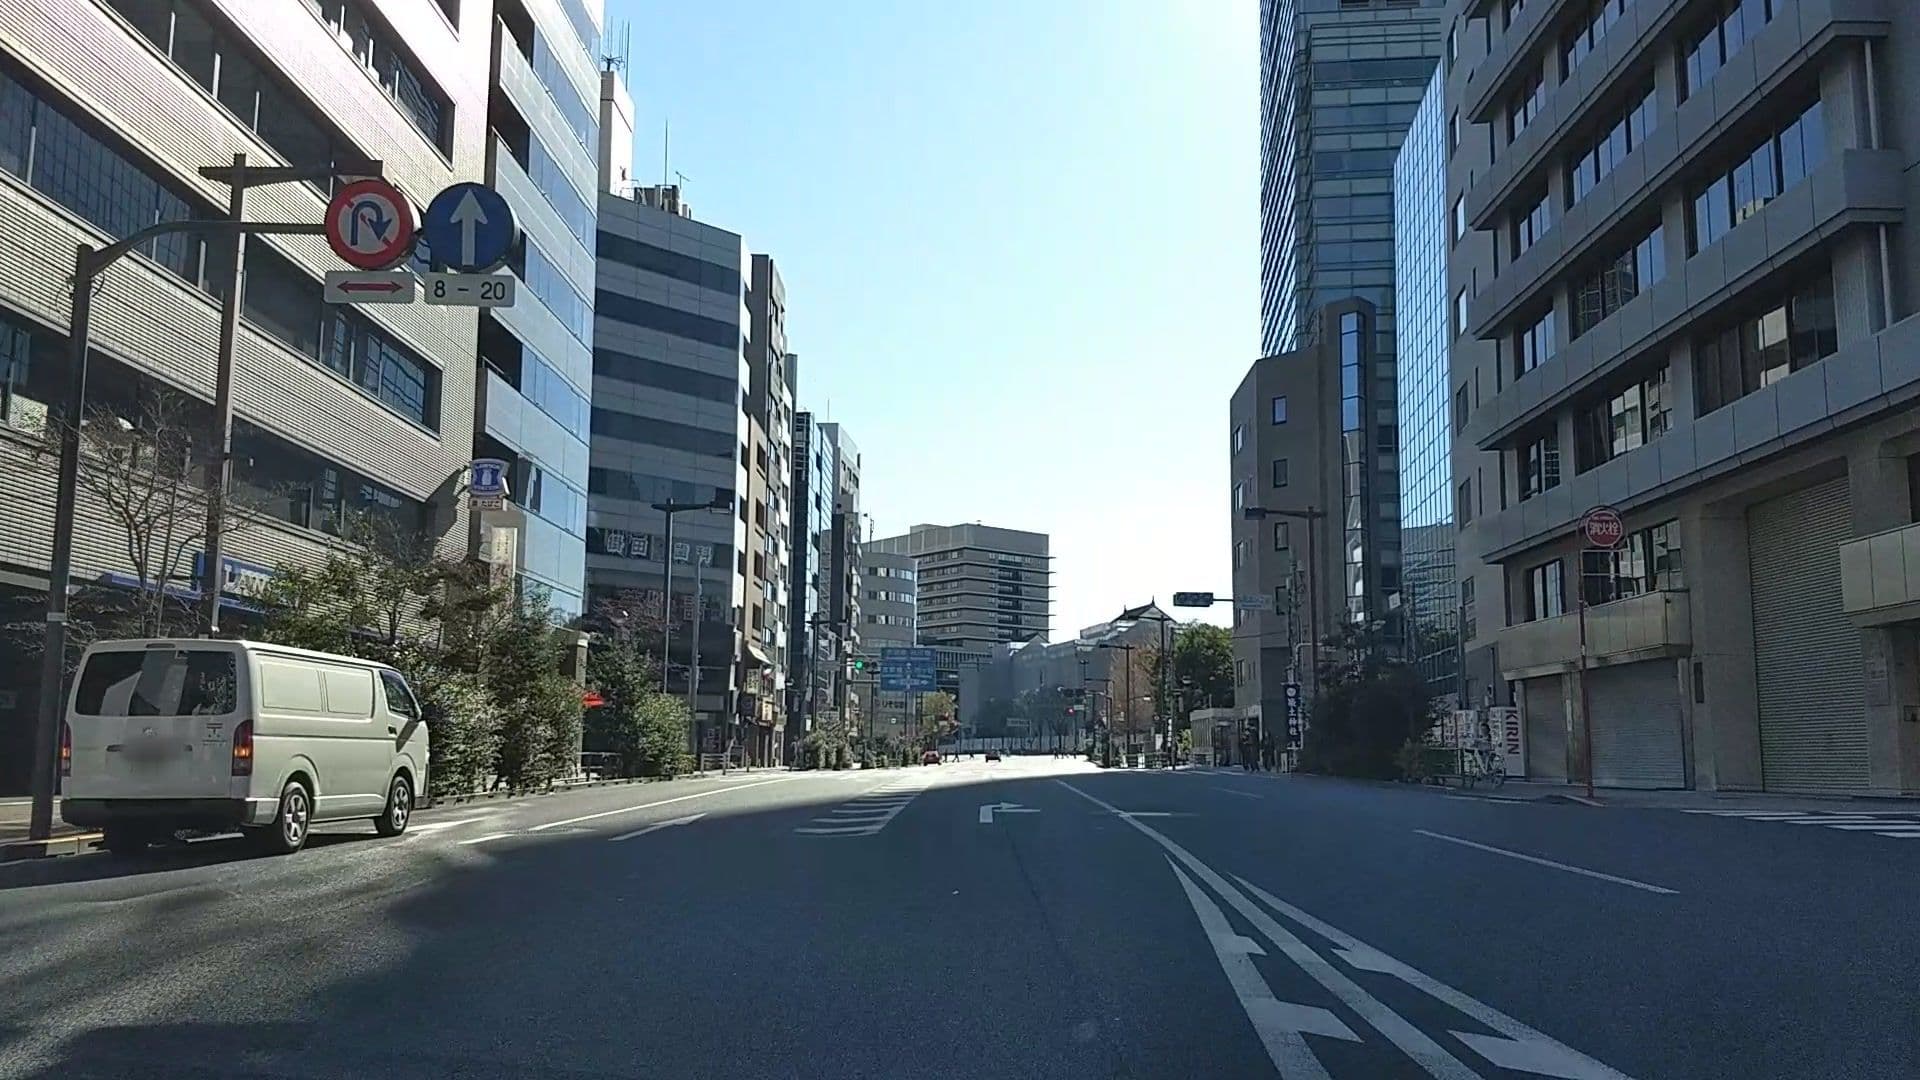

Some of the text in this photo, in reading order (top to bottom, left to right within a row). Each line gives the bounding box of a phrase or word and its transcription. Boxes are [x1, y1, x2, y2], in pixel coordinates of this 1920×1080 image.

[434, 280, 446, 298] 8
[480, 281, 506, 300] 20
[1588, 521, 1619, 537] 消火栓
[1505, 710, 1519, 754] KIRIN
